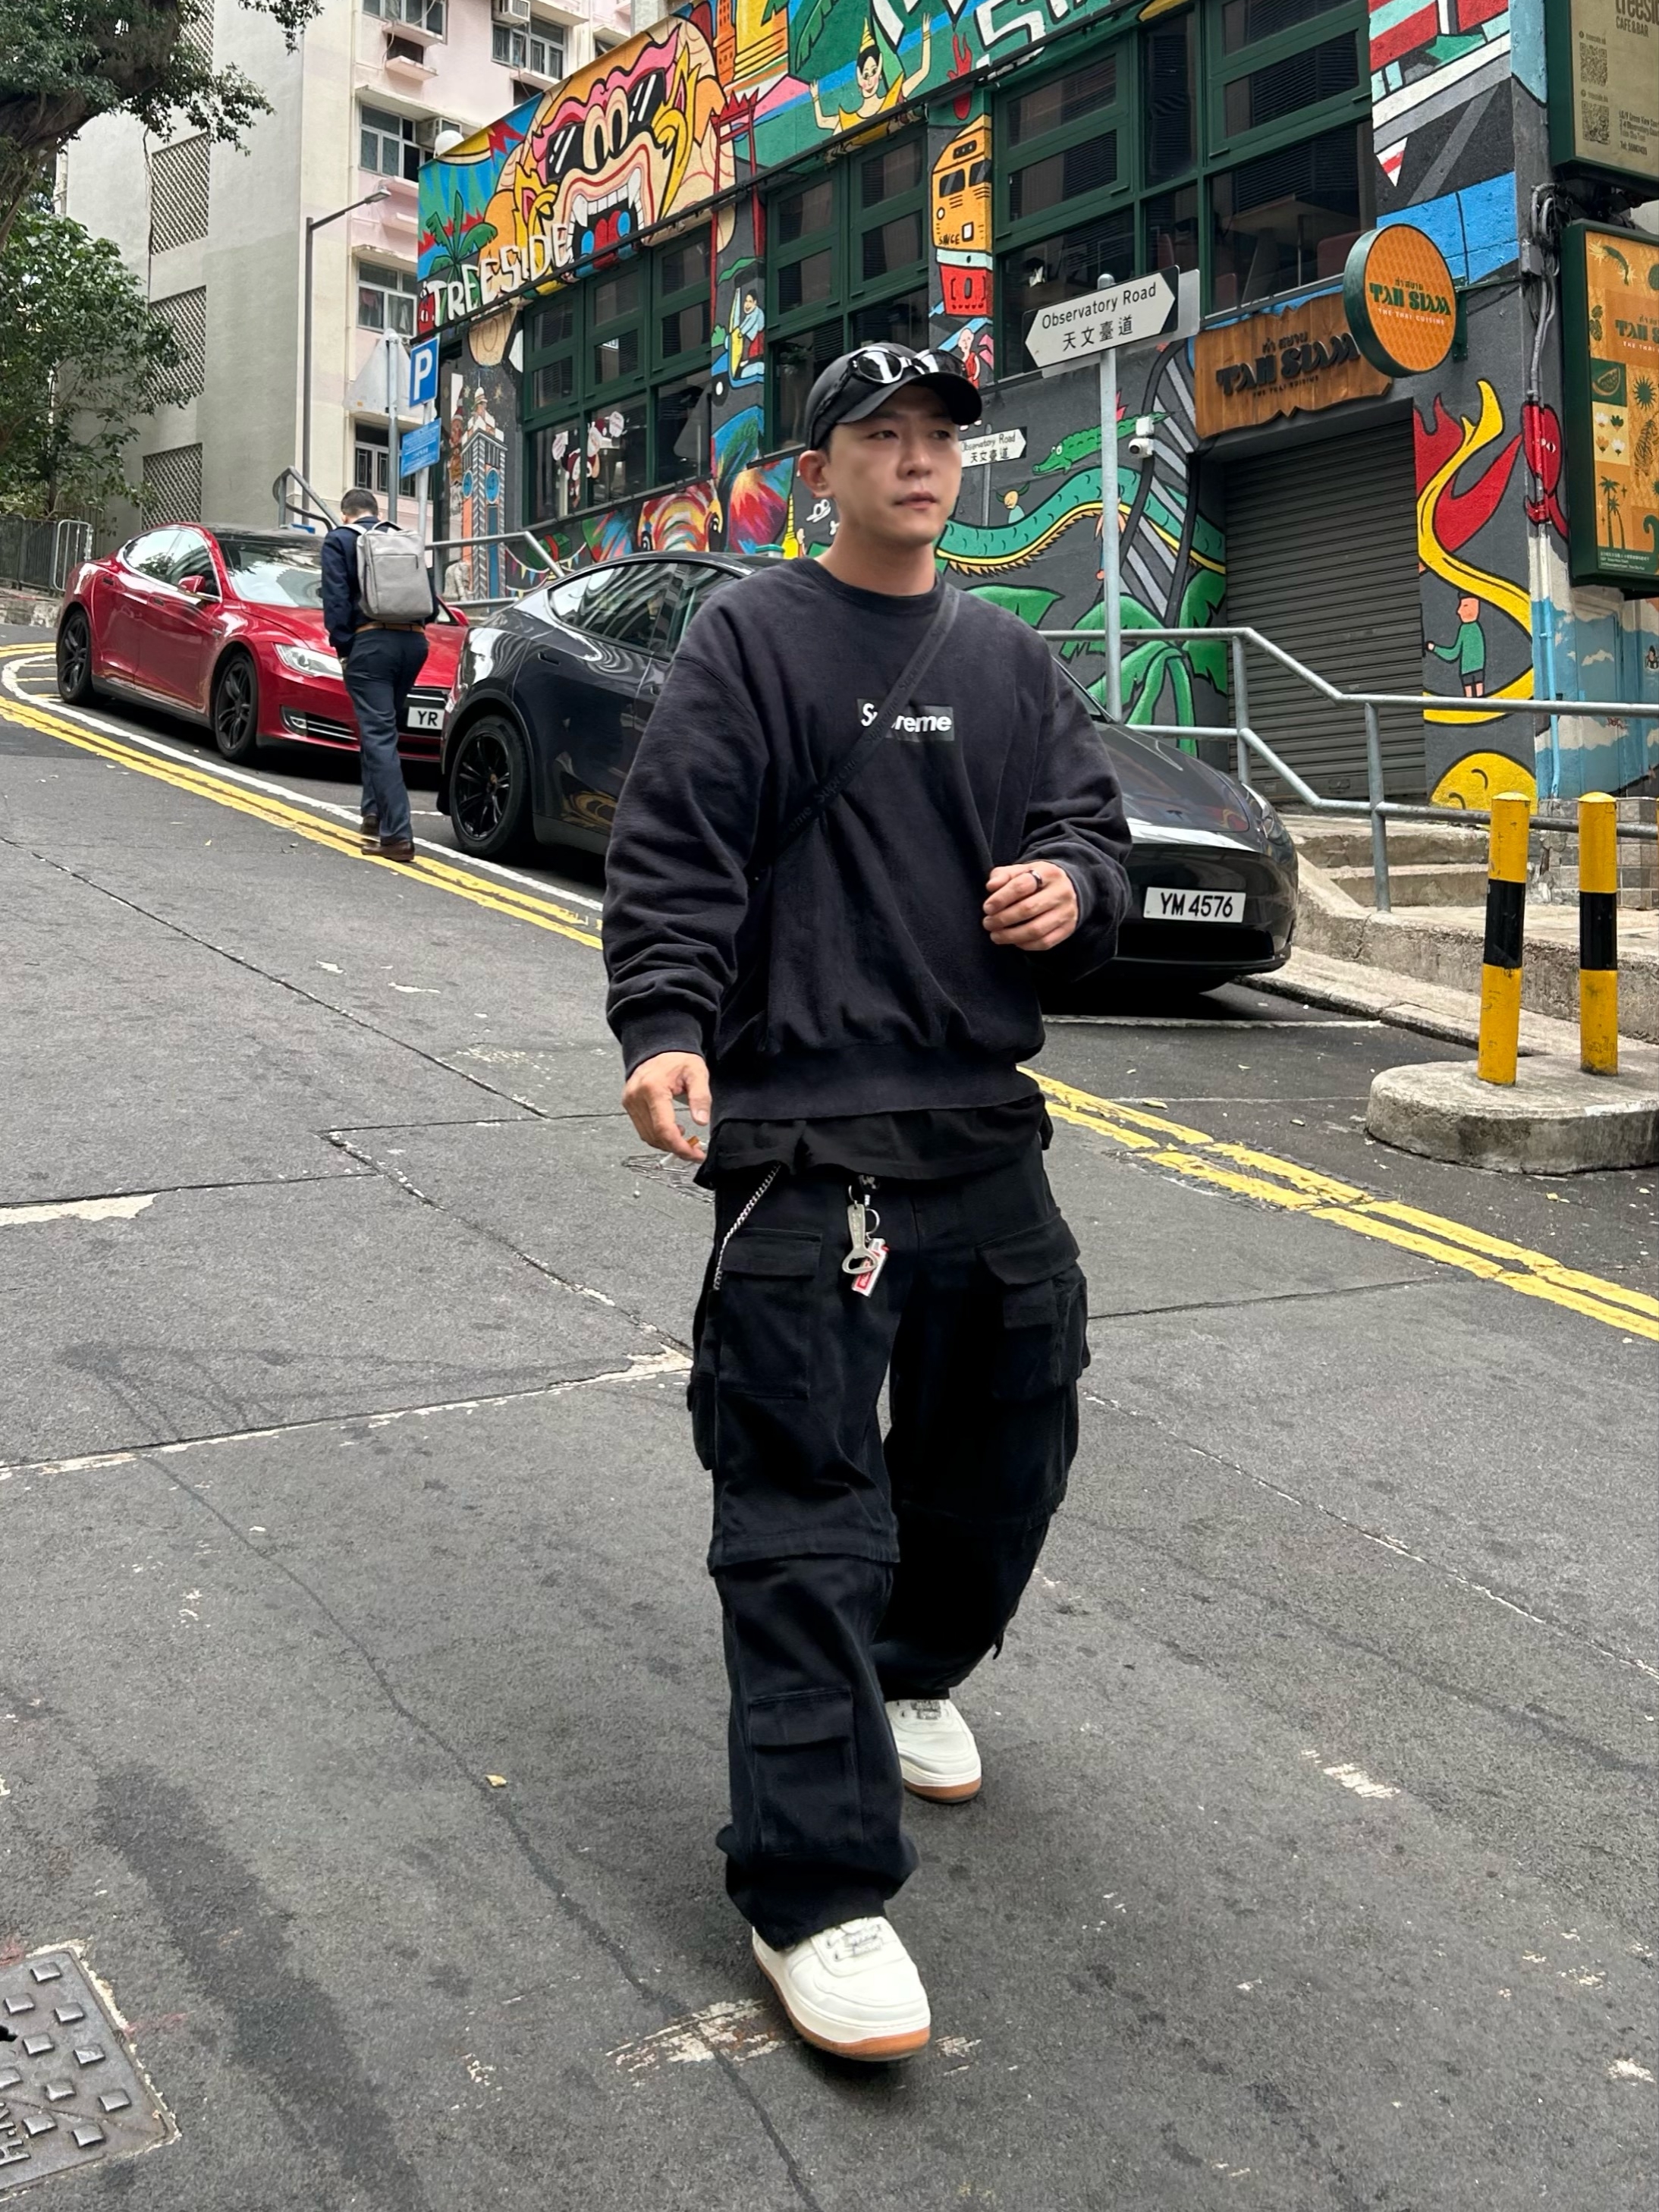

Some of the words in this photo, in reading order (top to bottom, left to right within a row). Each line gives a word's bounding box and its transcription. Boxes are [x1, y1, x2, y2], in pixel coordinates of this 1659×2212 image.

[426, 223, 574, 327] TREESIDE
[1042, 296, 1118, 329] Observatory
[1123, 281, 1157, 305] Road
[1378, 308, 1392, 316] THE
[1396, 311, 1412, 319] THAI
[1063, 314, 1133, 352] 天文臺道
[1623, 341, 1635, 349] THE
[413, 348, 433, 401] P
[998, 431, 1016, 444] Road
[417, 710, 438, 727] YR
[861, 702, 952, 733] Sreme
[1161, 892, 1186, 916] YM
[1188, 894, 1233, 918] 4576
